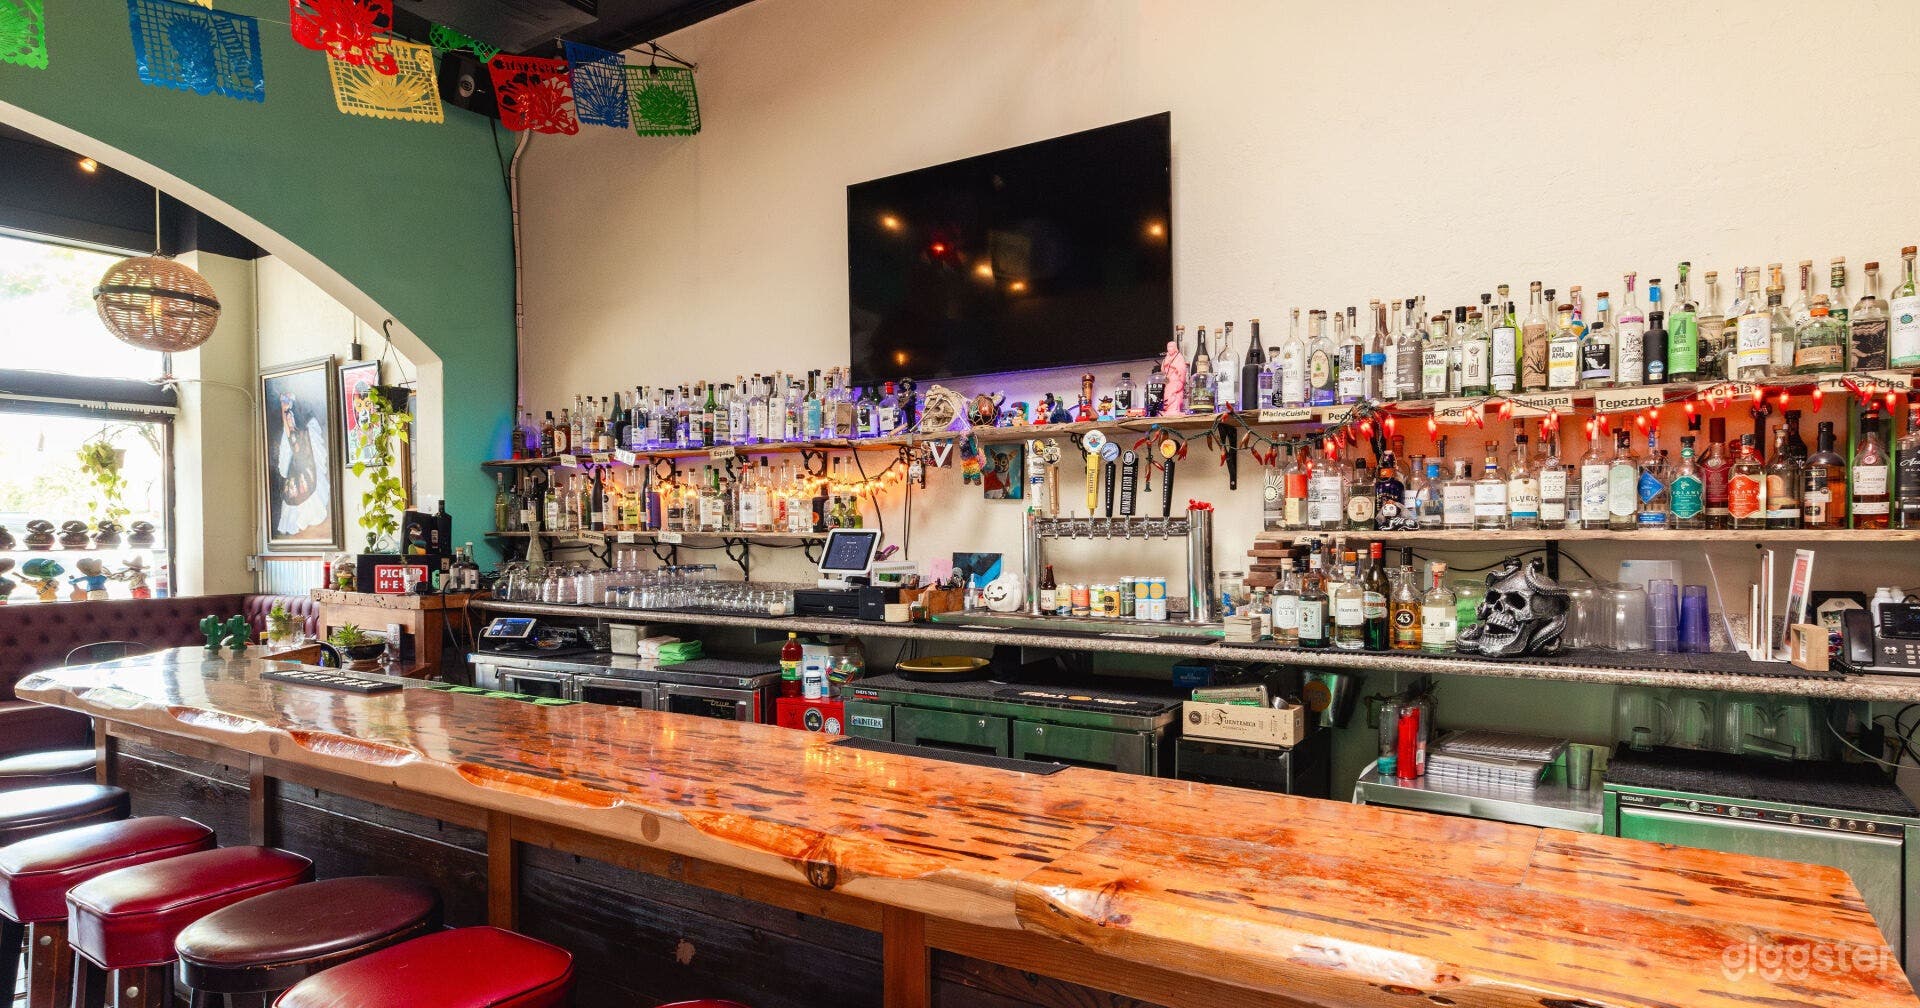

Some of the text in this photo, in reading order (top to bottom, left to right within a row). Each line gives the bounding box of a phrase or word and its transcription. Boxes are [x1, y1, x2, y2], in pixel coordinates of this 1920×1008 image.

[1597, 395, 1662, 409] Tepeztate
[1123, 466, 1133, 475] DEL
[1121, 491, 1132, 514] BREWING
[1396, 613, 1411, 623] 43
[1621, 795, 1645, 803] ECOLAB
